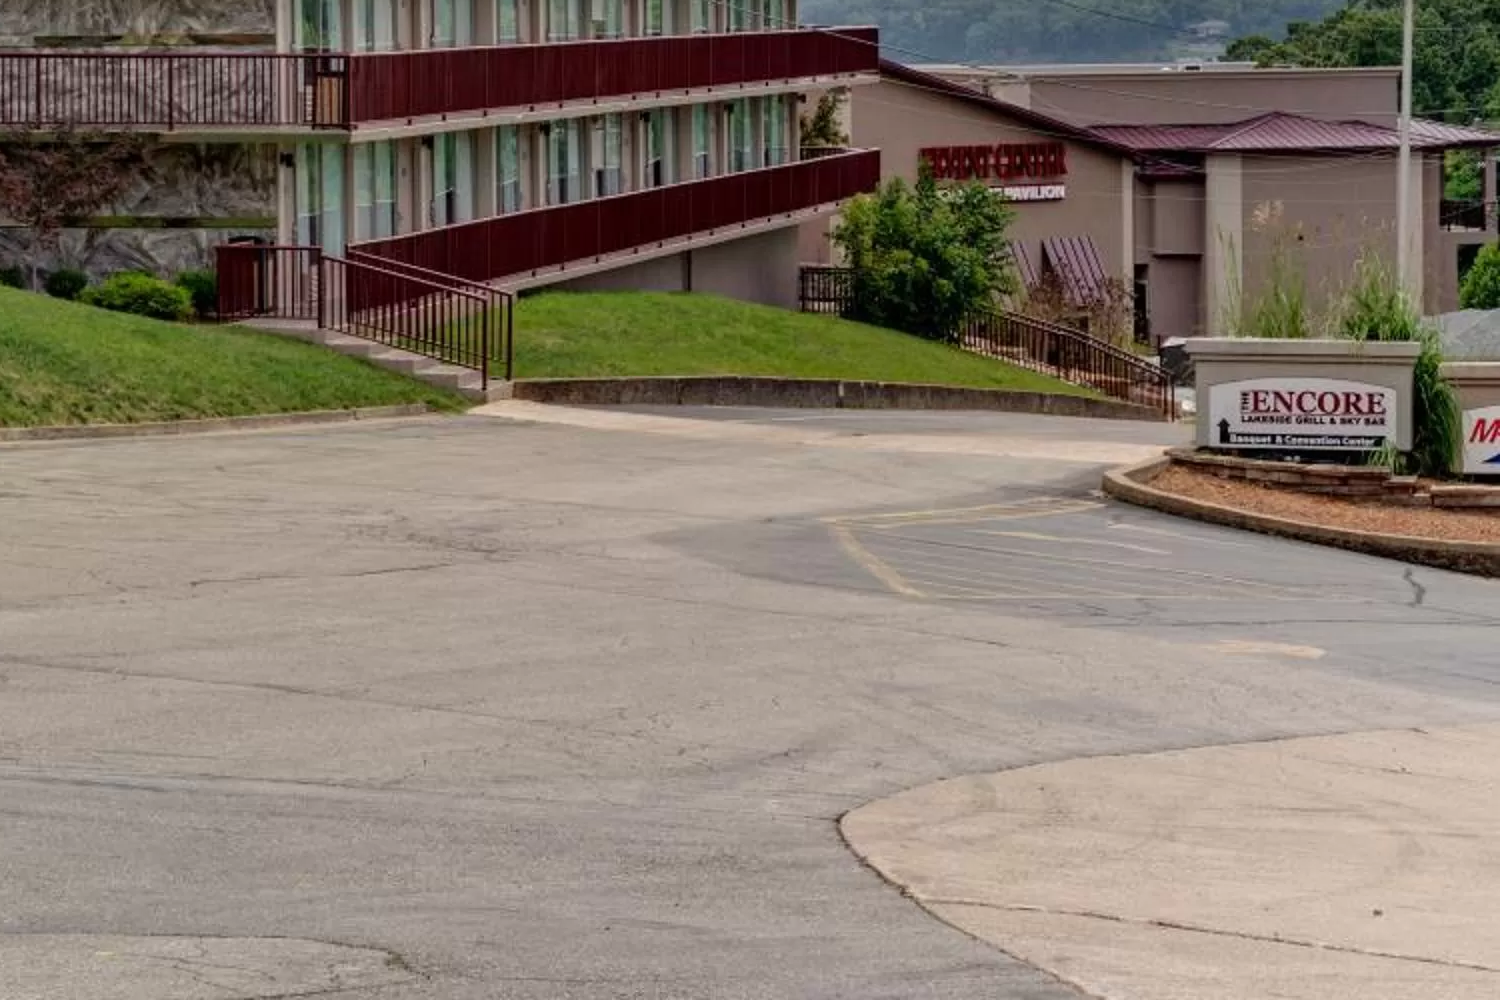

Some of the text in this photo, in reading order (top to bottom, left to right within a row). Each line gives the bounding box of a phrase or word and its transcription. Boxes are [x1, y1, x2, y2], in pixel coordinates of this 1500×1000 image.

[1251, 390, 1387, 415] ENCORE
[1241, 415, 1293, 425] LAKESIDE
[1295, 416, 1326, 425] GRILL
[1329, 417, 1337, 425] &
[1363, 417, 1386, 426] BAR
[1229, 434, 1271, 445] Banquet
[1284, 435, 1341, 446] Convention
[1342, 436, 1376, 446] Center
